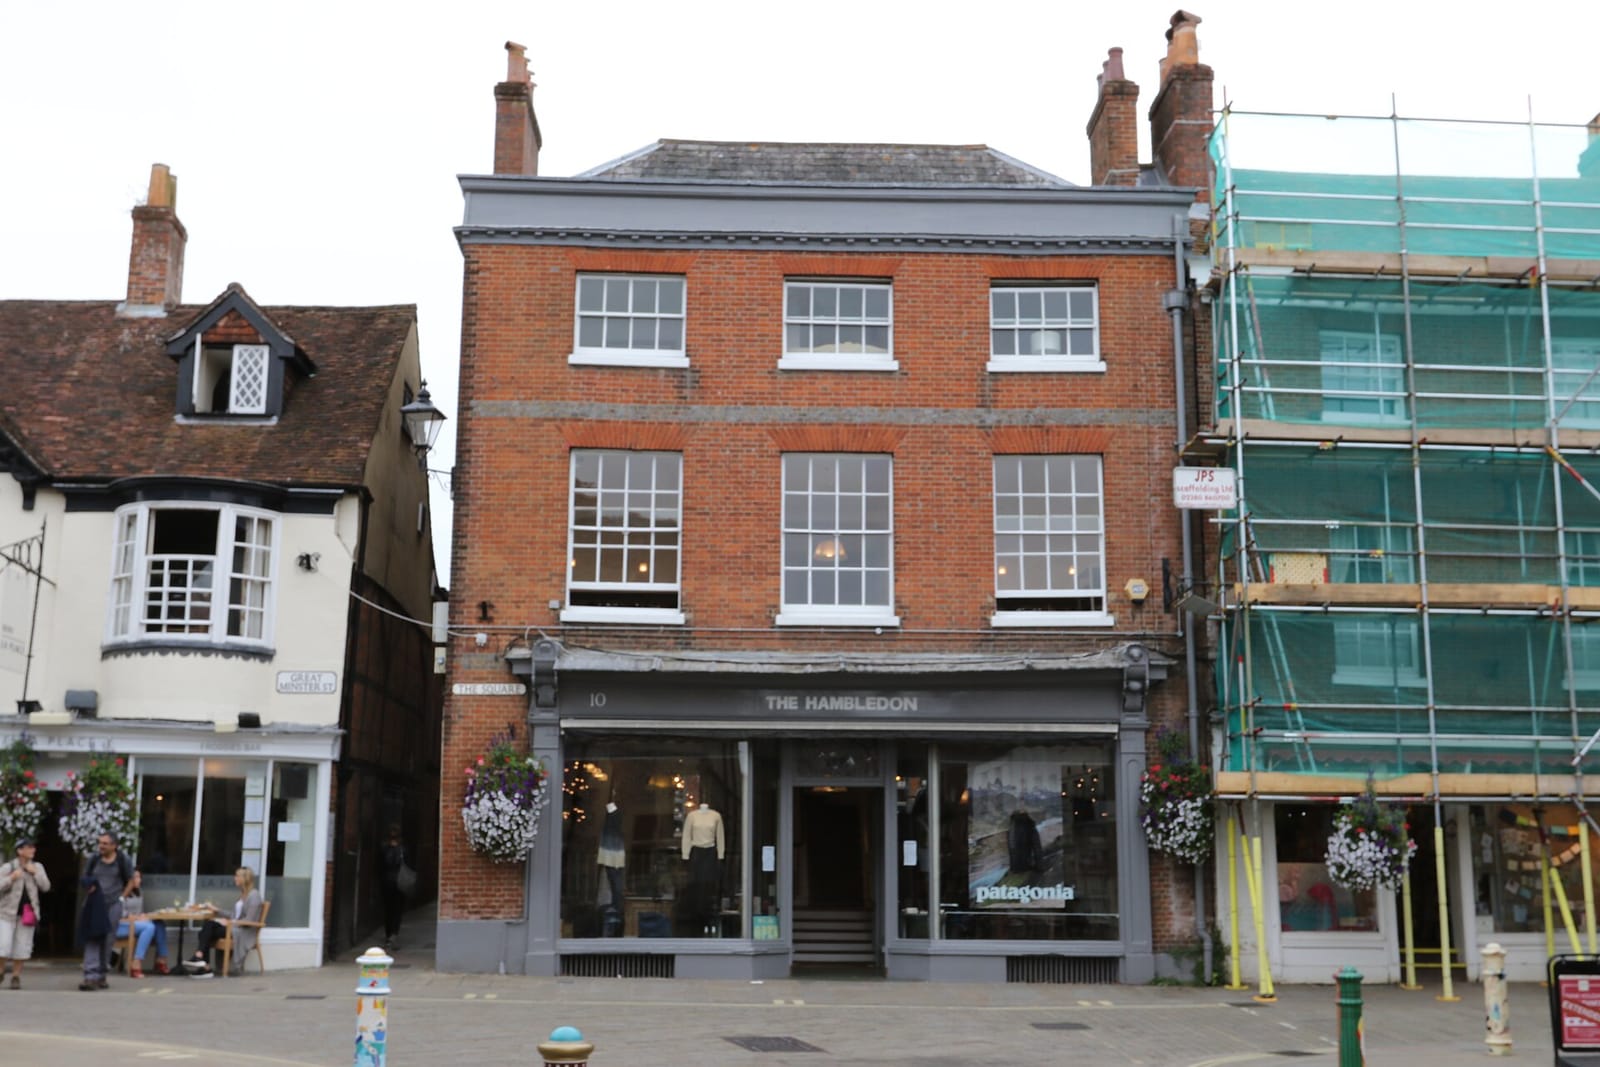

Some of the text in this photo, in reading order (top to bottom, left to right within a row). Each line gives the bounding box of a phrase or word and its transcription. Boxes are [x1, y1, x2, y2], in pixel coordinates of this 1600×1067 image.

[1194, 469, 1215, 482] JPS
[1176, 483, 1220, 494] scaffolding
[290, 672, 322, 682] GREAT
[458, 684, 522, 694] THE SQUARE
[589, 692, 607, 707] 10
[765, 695, 918, 711] THE HAMBLEDON
[976, 883, 1075, 904] patagonia
